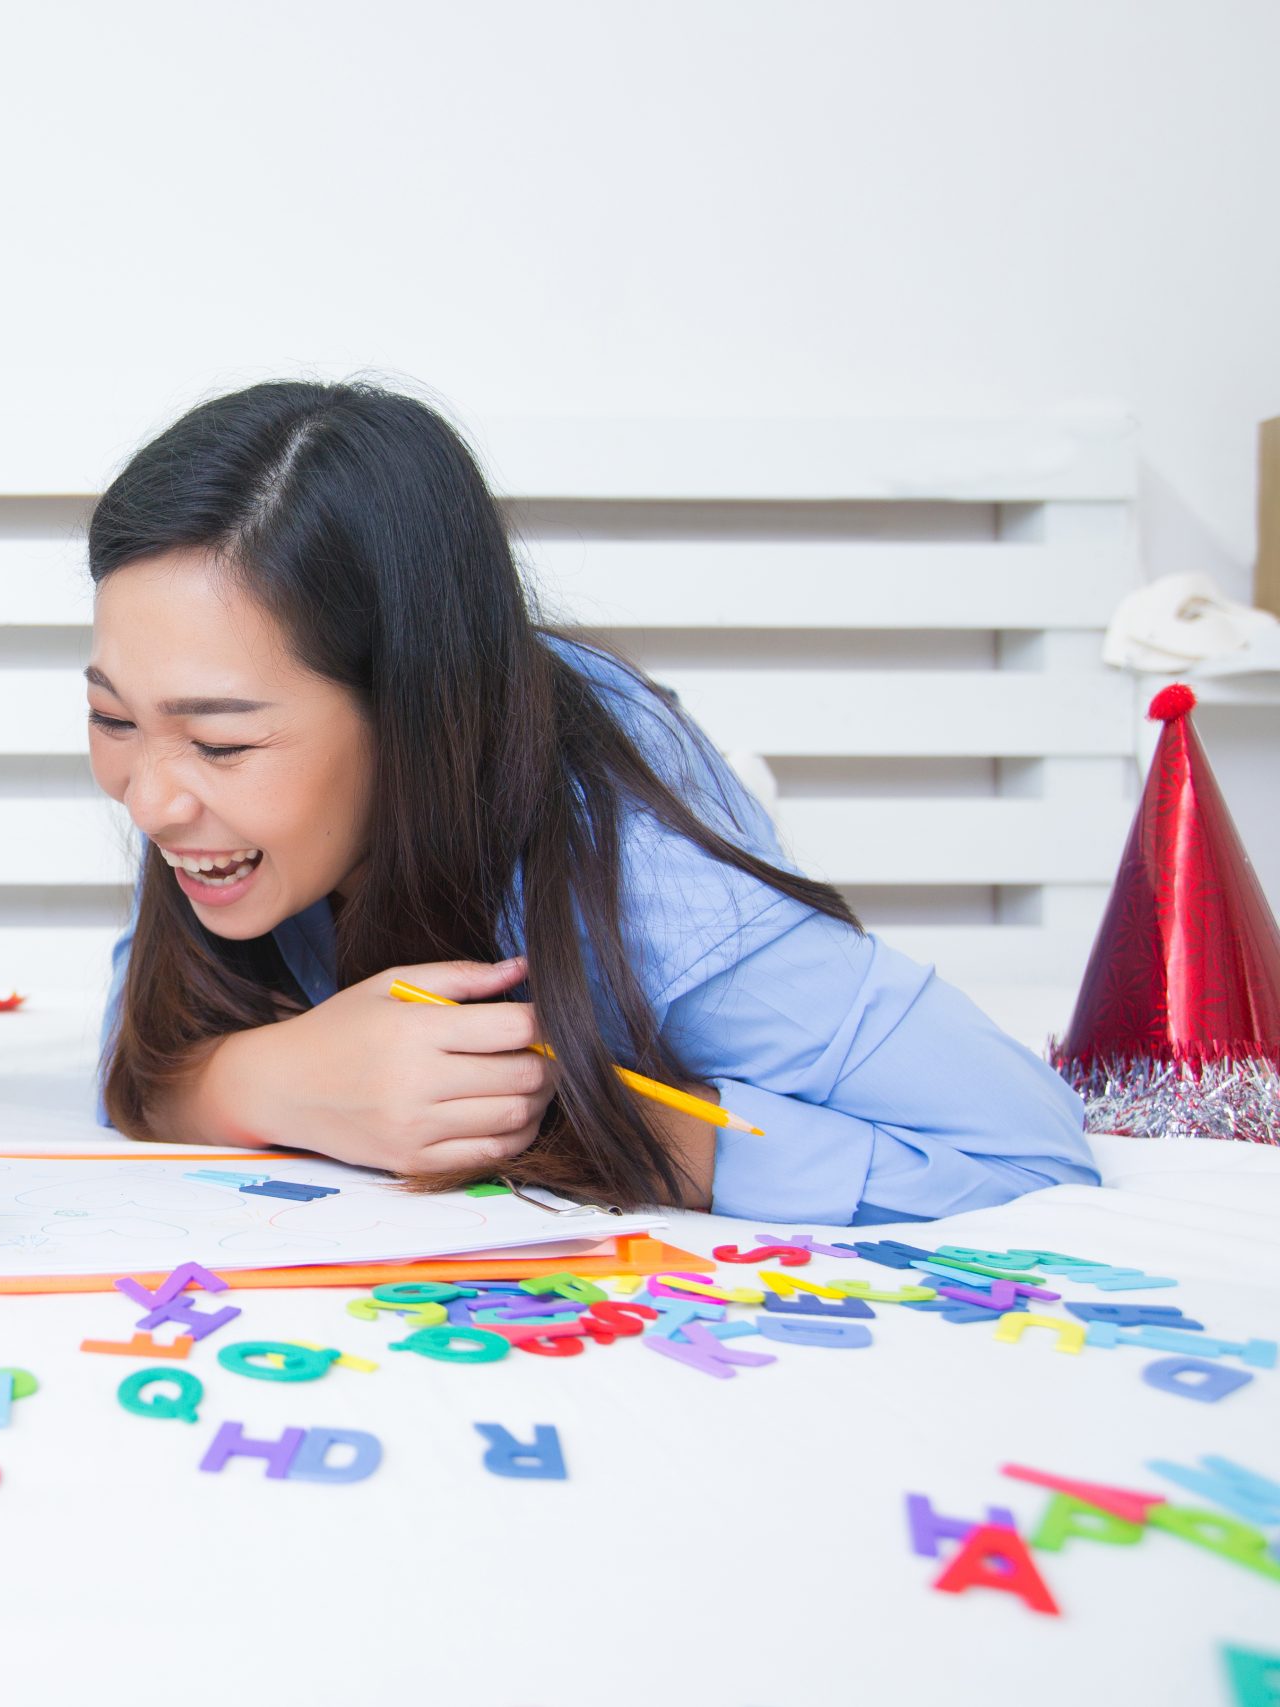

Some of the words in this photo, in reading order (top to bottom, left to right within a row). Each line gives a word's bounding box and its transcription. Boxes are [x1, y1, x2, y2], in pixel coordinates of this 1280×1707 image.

[712, 1244, 812, 1267] S
[216, 1340, 342, 1383] Q
[641, 1322, 779, 1379] K
[117, 1366, 205, 1425] Q
[197, 1420, 307, 1481] H
[287, 1425, 384, 1485] D
[473, 1421, 569, 1481] R
[931, 1522, 1063, 1618] A
